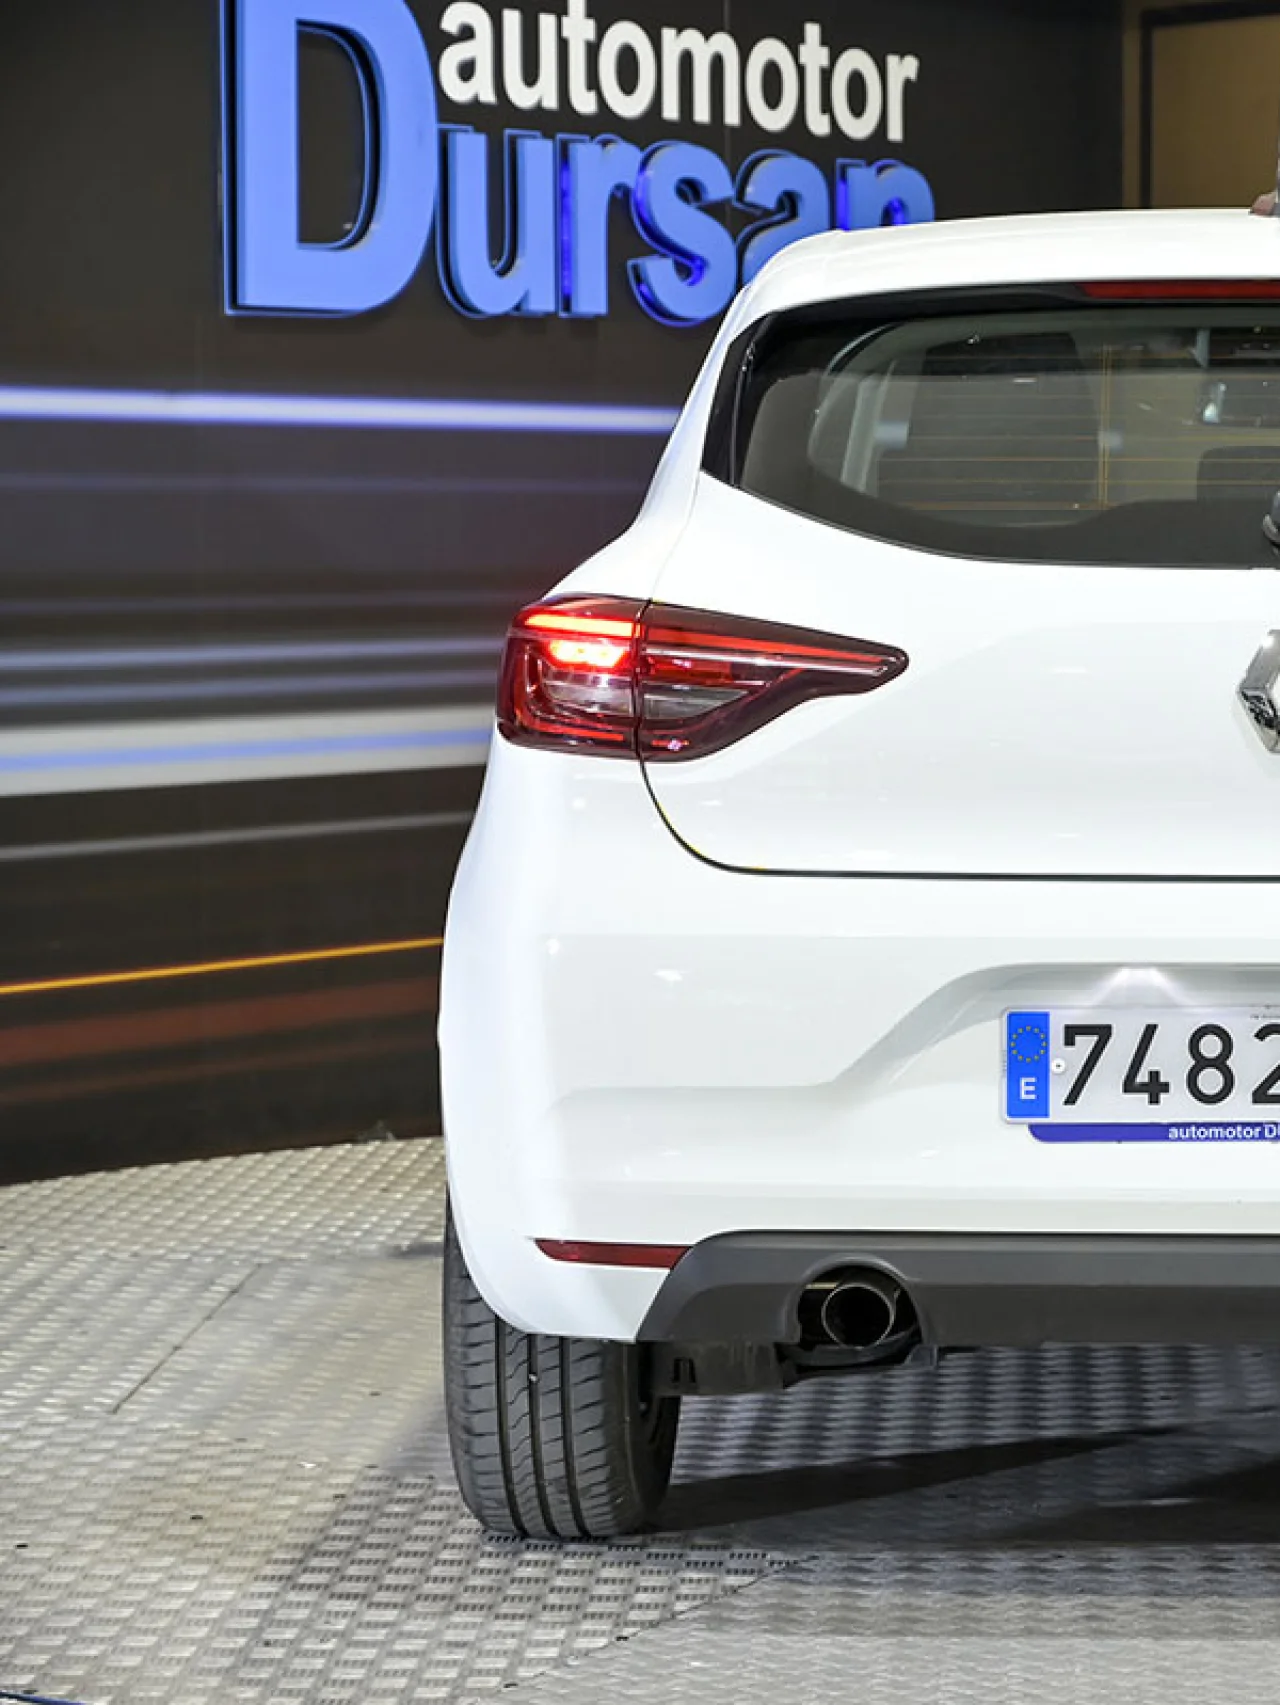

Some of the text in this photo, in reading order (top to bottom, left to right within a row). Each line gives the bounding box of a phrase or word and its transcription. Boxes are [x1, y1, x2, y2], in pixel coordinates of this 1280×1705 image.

[438, 0, 920, 142] automotor
[1020, 1077, 1037, 1100] E
[1168, 1124, 1262, 1140] automotor
